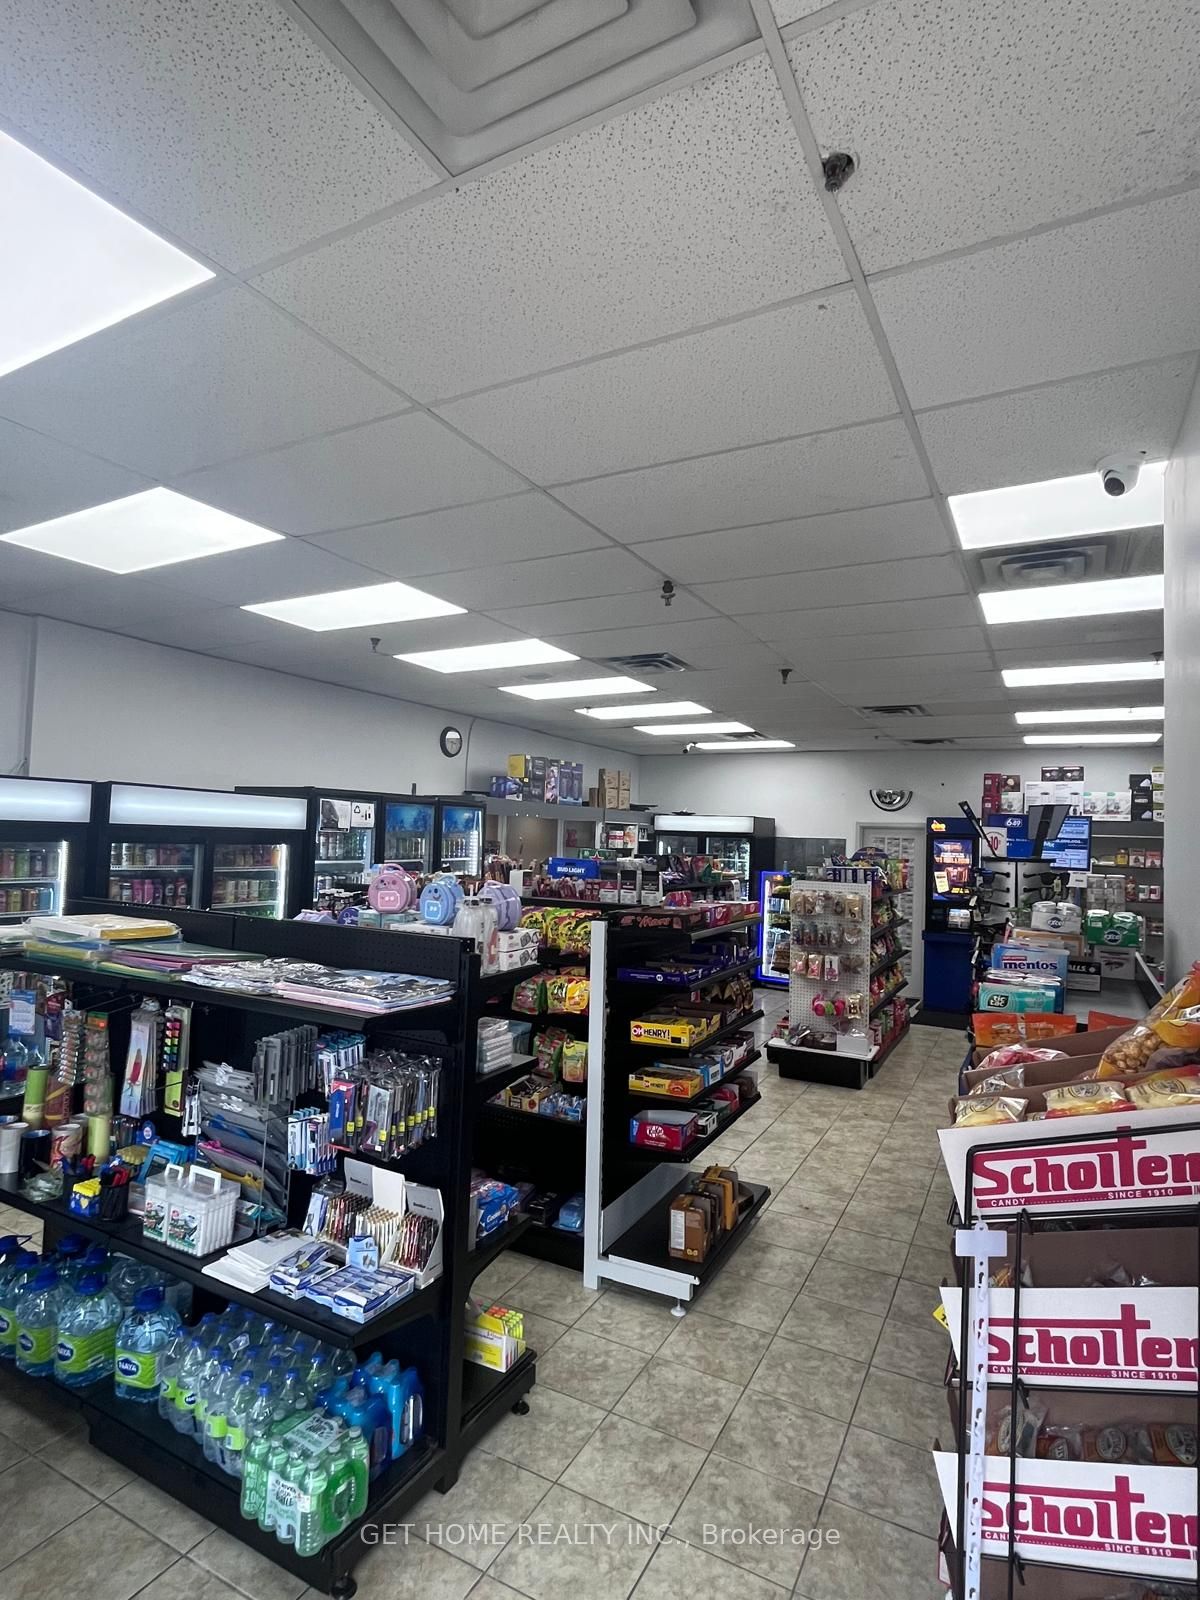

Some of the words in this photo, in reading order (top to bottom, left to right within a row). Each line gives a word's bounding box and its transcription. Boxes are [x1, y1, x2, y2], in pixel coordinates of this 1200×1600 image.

[1003, 960, 1058, 970] mentos
[644, 1030, 670, 1040] HENRY!
[972, 1126, 1200, 1197] Scholten
[990, 1198, 1026, 1207] CANDY
[1107, 1190, 1142, 1199] SINCE
[1147, 1188, 1174, 1197] 1910
[1111, 1370, 1146, 1379] SINCE
[1151, 1372, 1178, 1380] 1910
[1104, 1543, 1140, 1555] SINCE
[1145, 1548, 1172, 1557] 1910
